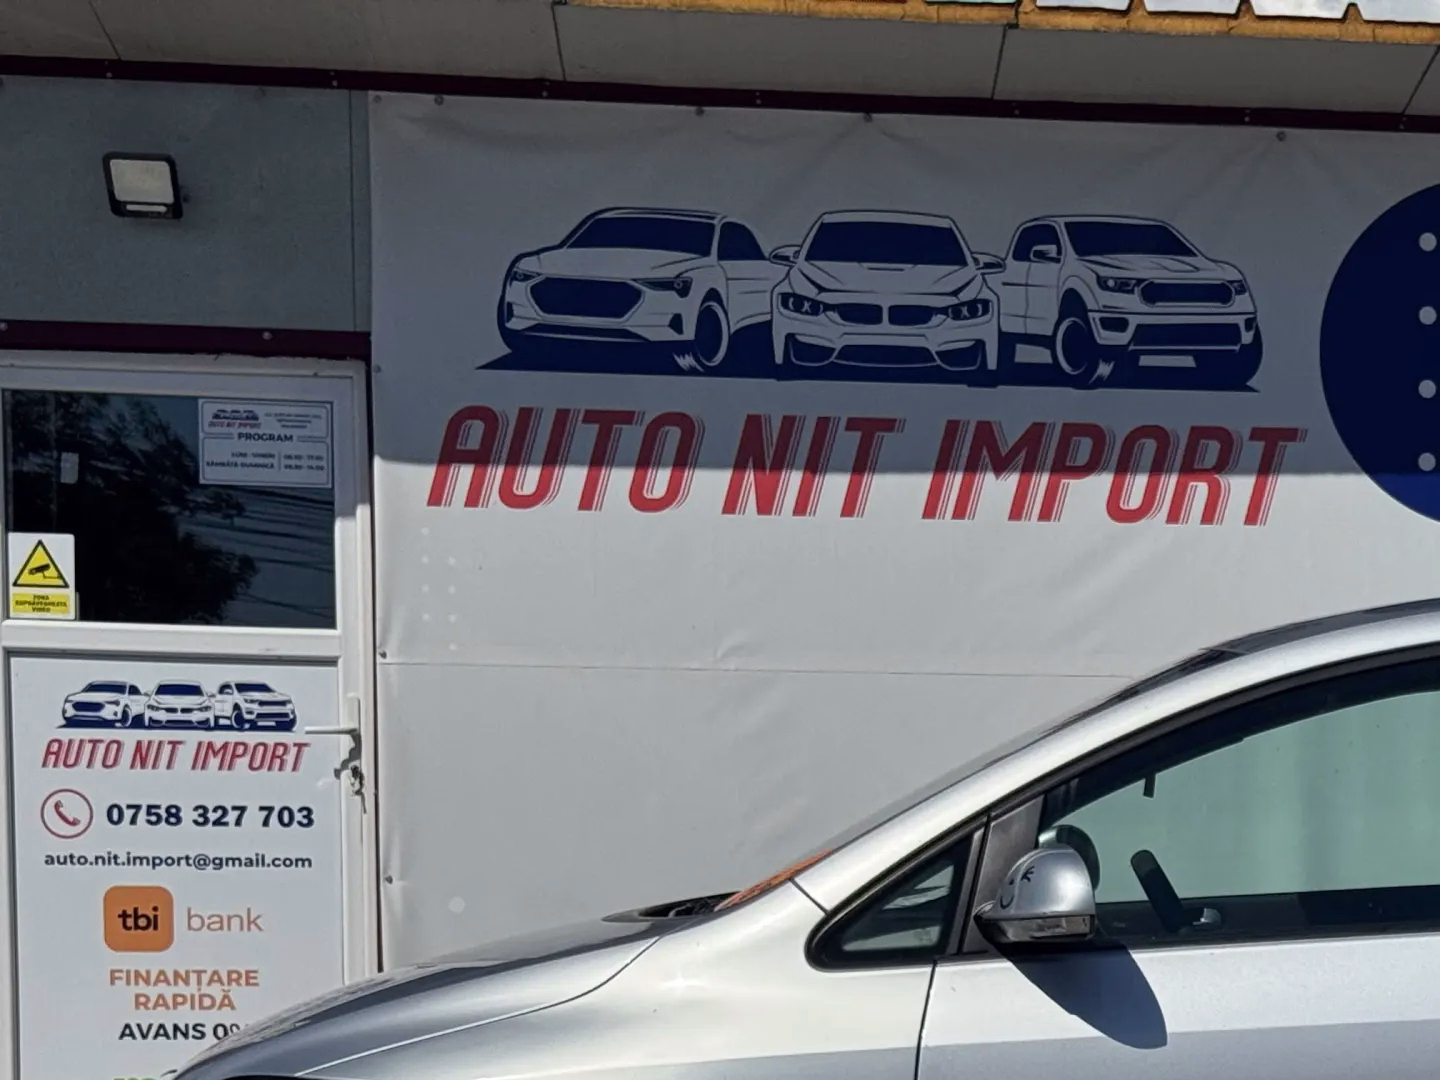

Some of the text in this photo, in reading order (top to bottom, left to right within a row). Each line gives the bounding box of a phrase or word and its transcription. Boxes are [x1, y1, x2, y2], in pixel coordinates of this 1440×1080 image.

[237, 432, 294, 443] PROGRAM
[426, 404, 1307, 526] AUTO NIT IMPORT
[41, 738, 312, 773] AUTO NIT IMPORT
[106, 803, 315, 829] 0758 327 703
[44, 851, 313, 871] auto.nit.import@gmail.com
[117, 906, 264, 932] tbi bank
[134, 989, 237, 1011] RAPIDĂ
[118, 1023, 206, 1041] AVANS
